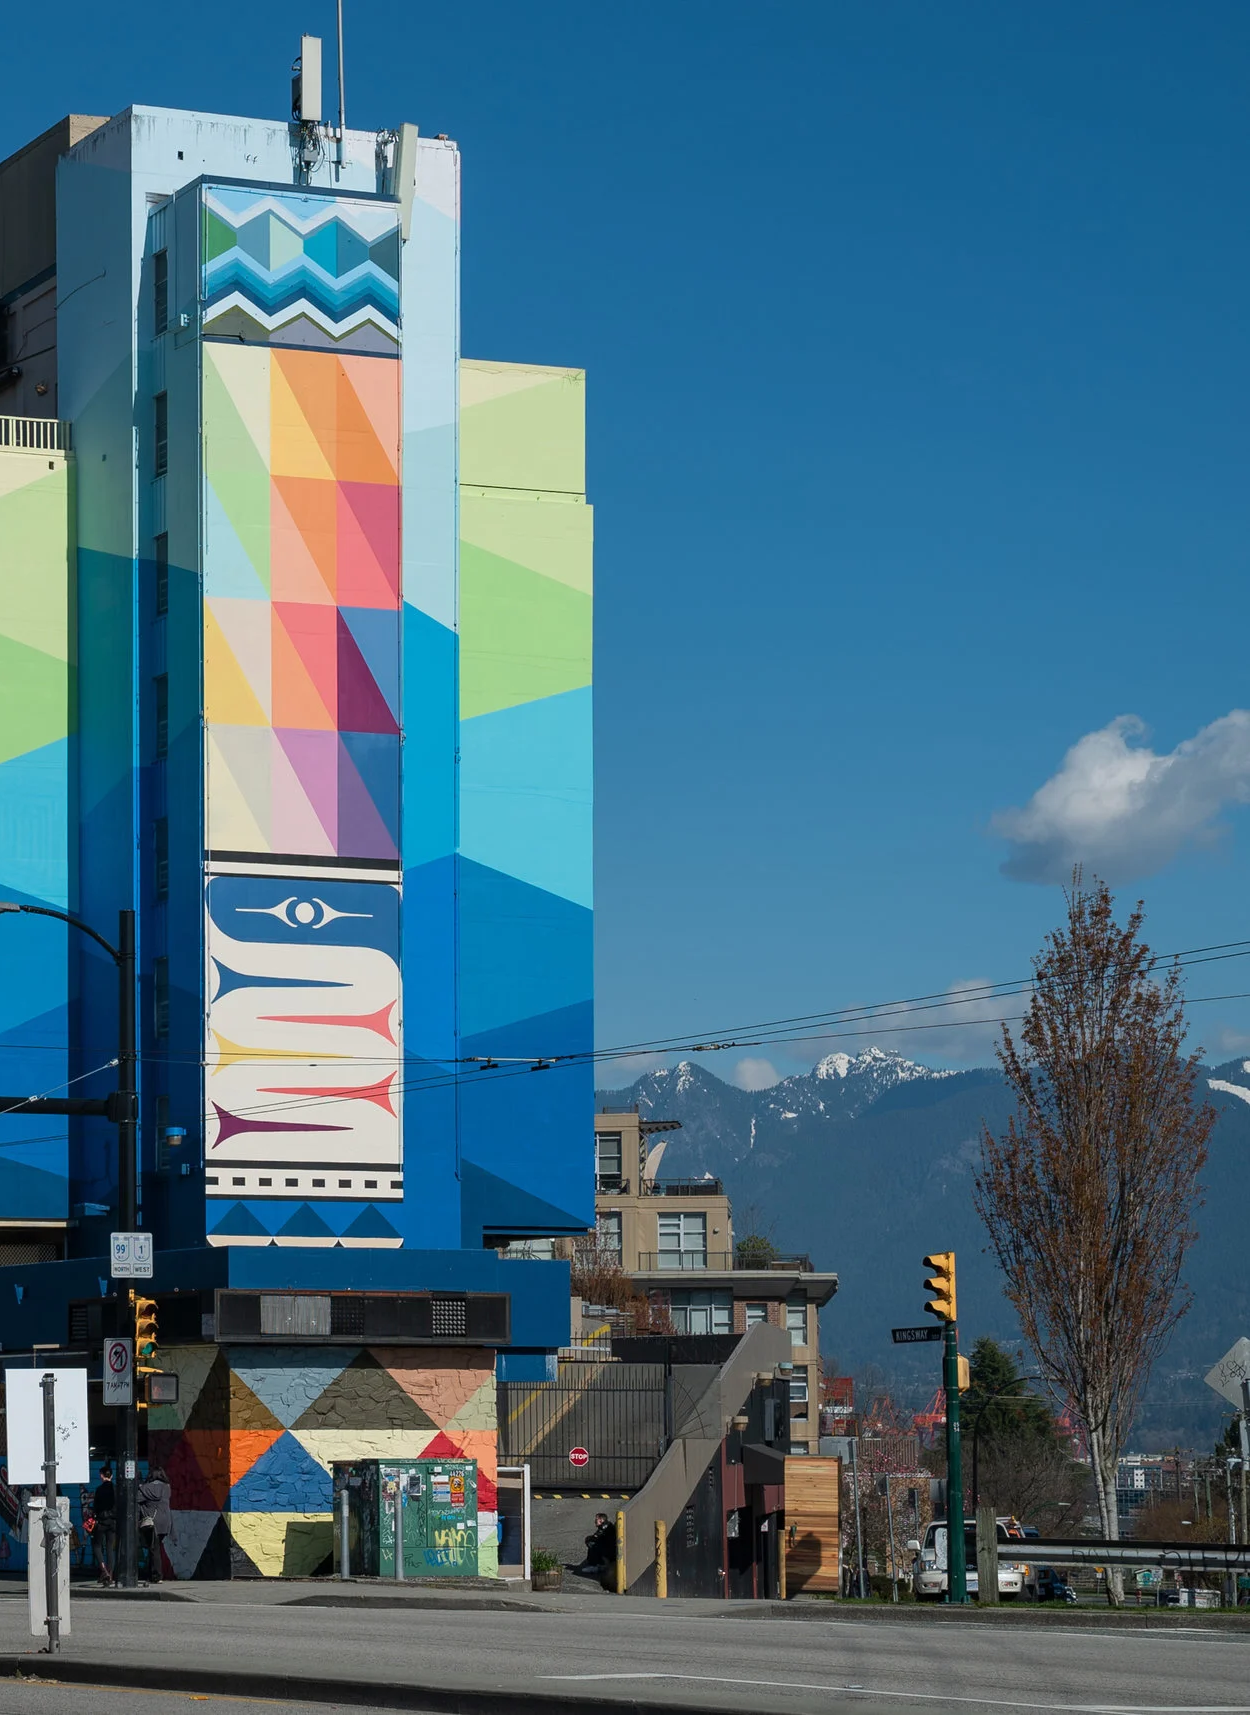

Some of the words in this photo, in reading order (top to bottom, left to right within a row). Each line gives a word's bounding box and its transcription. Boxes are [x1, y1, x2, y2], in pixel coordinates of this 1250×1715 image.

[115, 1244, 126, 1254] 99
[139, 1245, 143, 1254] 1
[895, 1329, 928, 1341] KINGSWAY
